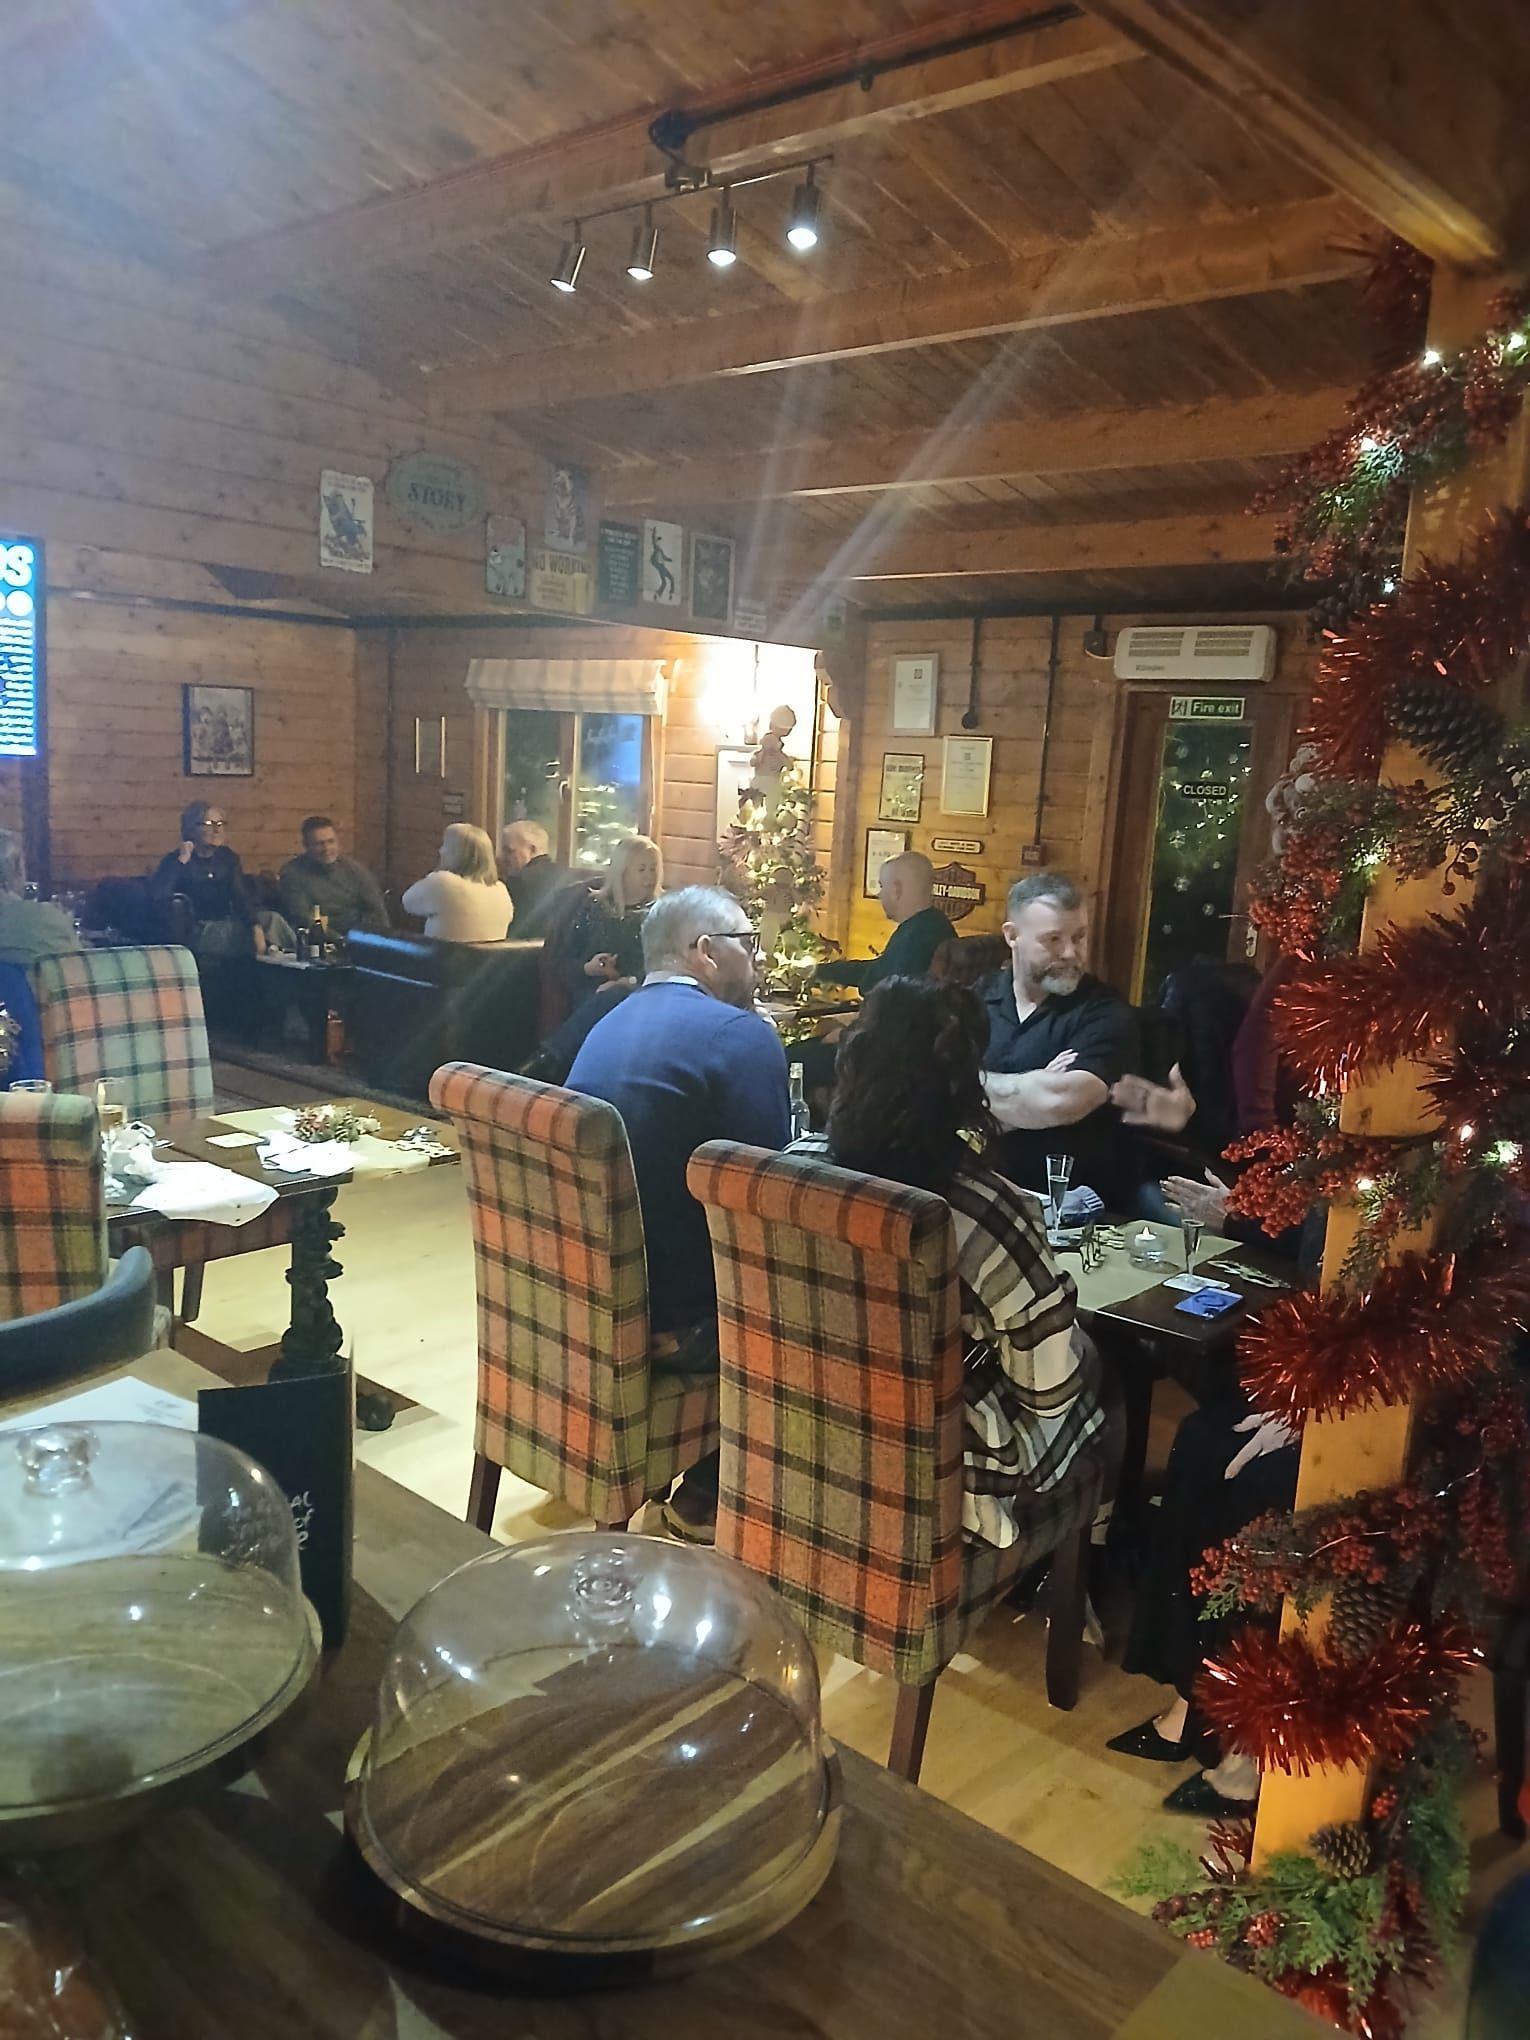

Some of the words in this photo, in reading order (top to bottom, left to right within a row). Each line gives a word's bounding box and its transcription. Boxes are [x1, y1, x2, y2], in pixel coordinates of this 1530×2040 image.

[1192, 702, 1215, 713] Fire
[1217, 703, 1240, 714] exit
[1183, 784, 1227, 796] CLOSED
